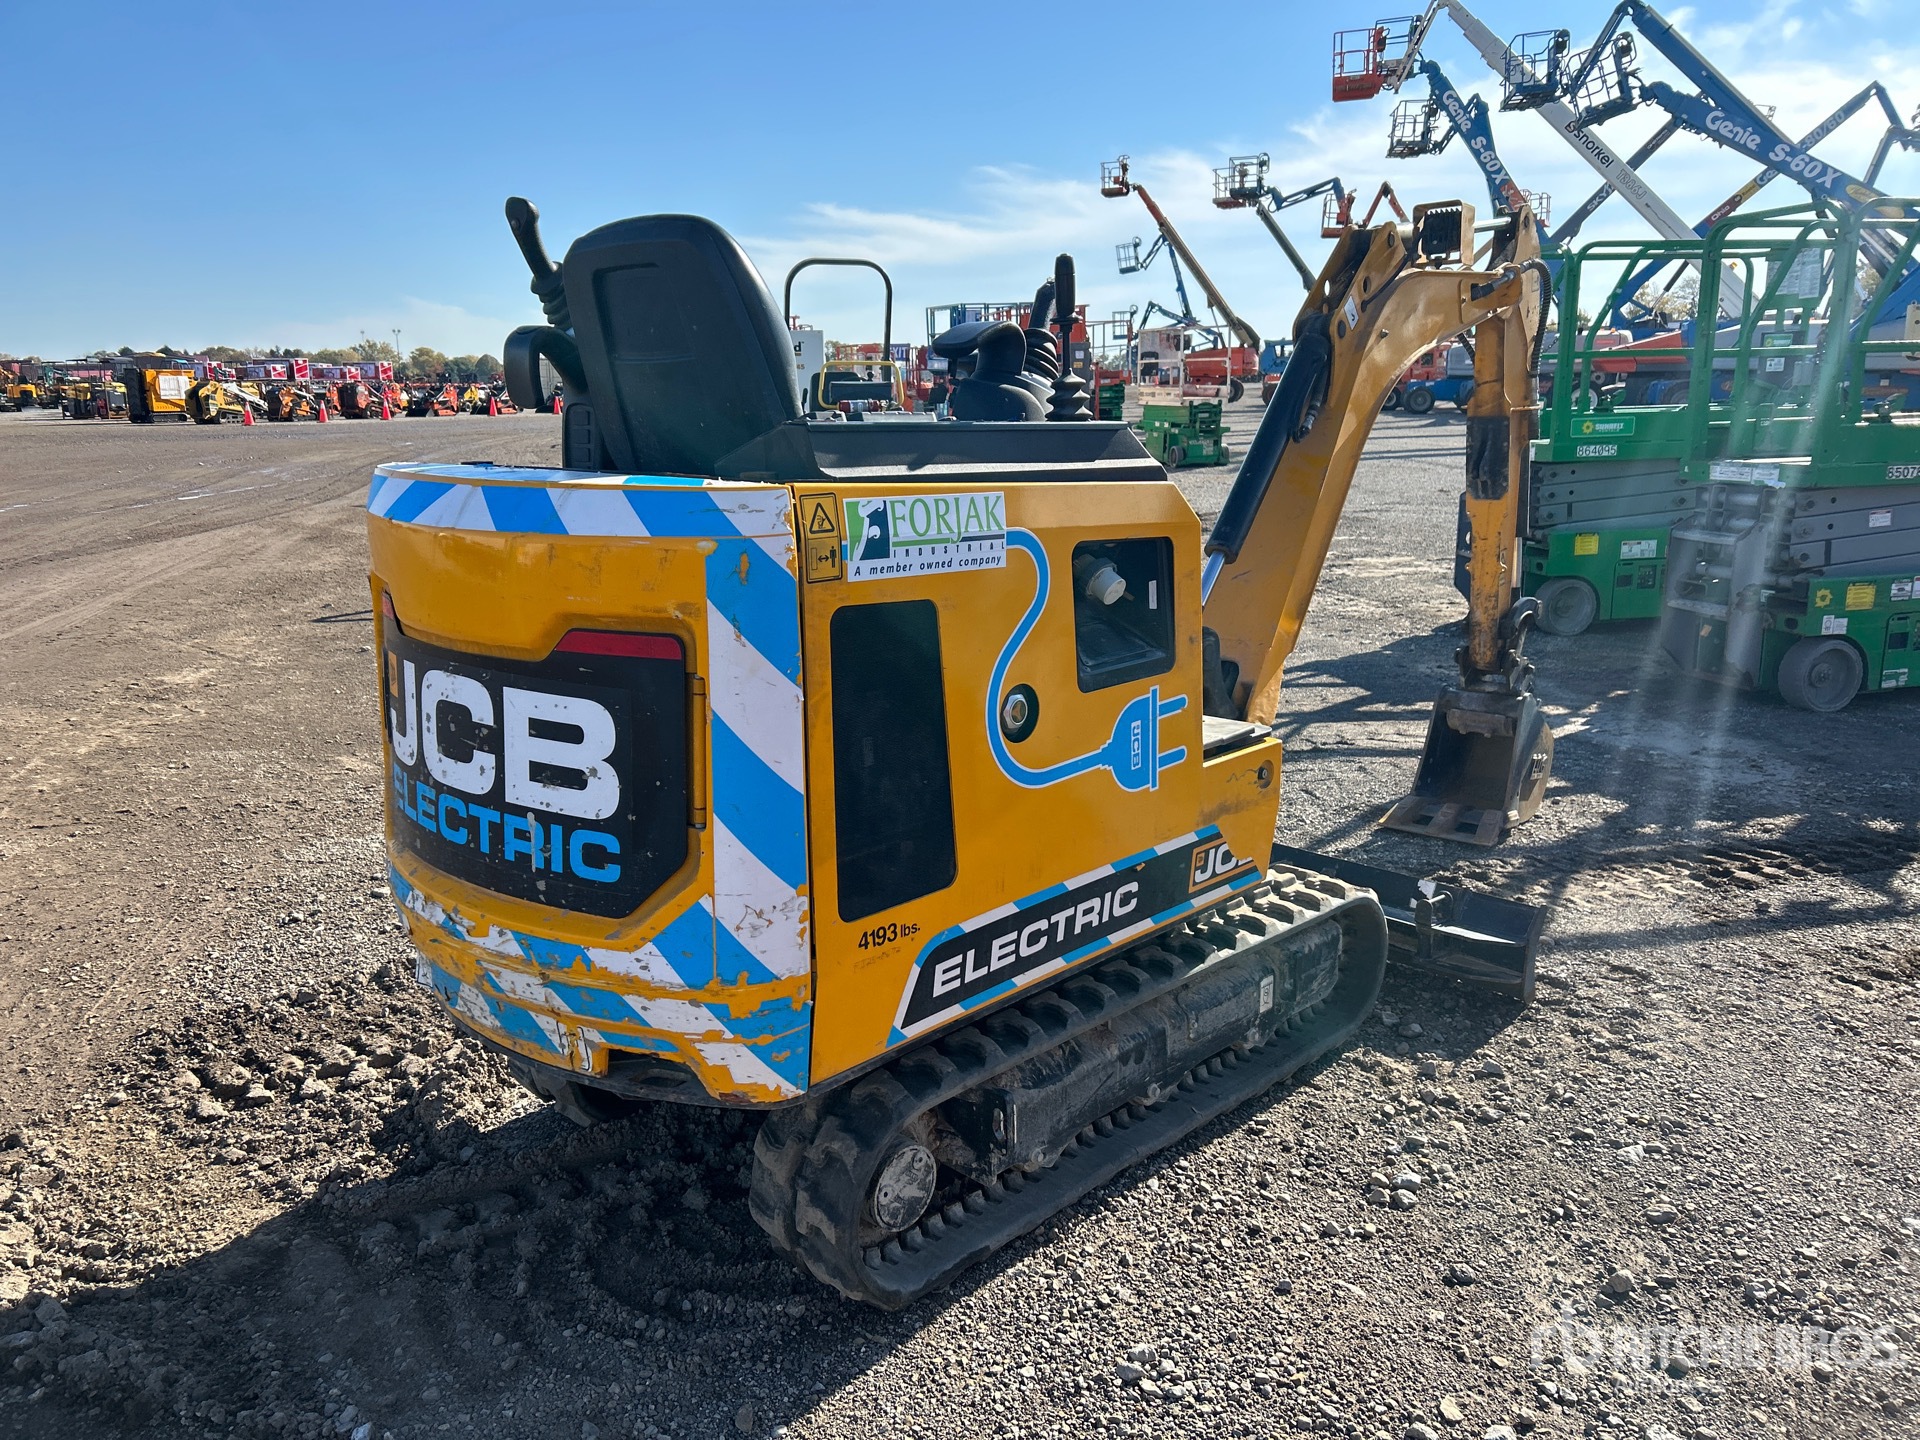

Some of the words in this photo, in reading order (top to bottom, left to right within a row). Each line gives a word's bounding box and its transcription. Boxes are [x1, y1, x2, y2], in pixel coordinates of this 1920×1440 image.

[1443, 90, 1472, 132] Genie
[1706, 110, 1762, 151] Genie
[1796, 111, 1845, 149] -80/60
[1573, 129, 1615, 168] snorkel
[1756, 169, 1779, 185] Ge
[1711, 205, 1731, 221] Ohio
[890, 346, 907, 359] XIT
[1578, 445, 1616, 456] 864095
[889, 495, 1005, 544] FORJAK
[854, 566, 861, 576] A
[869, 561, 913, 576] member
[919, 558, 953, 570] owned
[958, 555, 1002, 567] company
[893, 543, 1005, 558] INDUSTRIAL
[390, 660, 621, 820] JCB
[1132, 722, 1141, 769] JCB
[394, 762, 621, 883] ELECTRIC
[1195, 843, 1254, 883] JC
[858, 923, 898, 950] 4193
[900, 923, 921, 938] lbs.
[932, 881, 1139, 998] ELECTRIC
